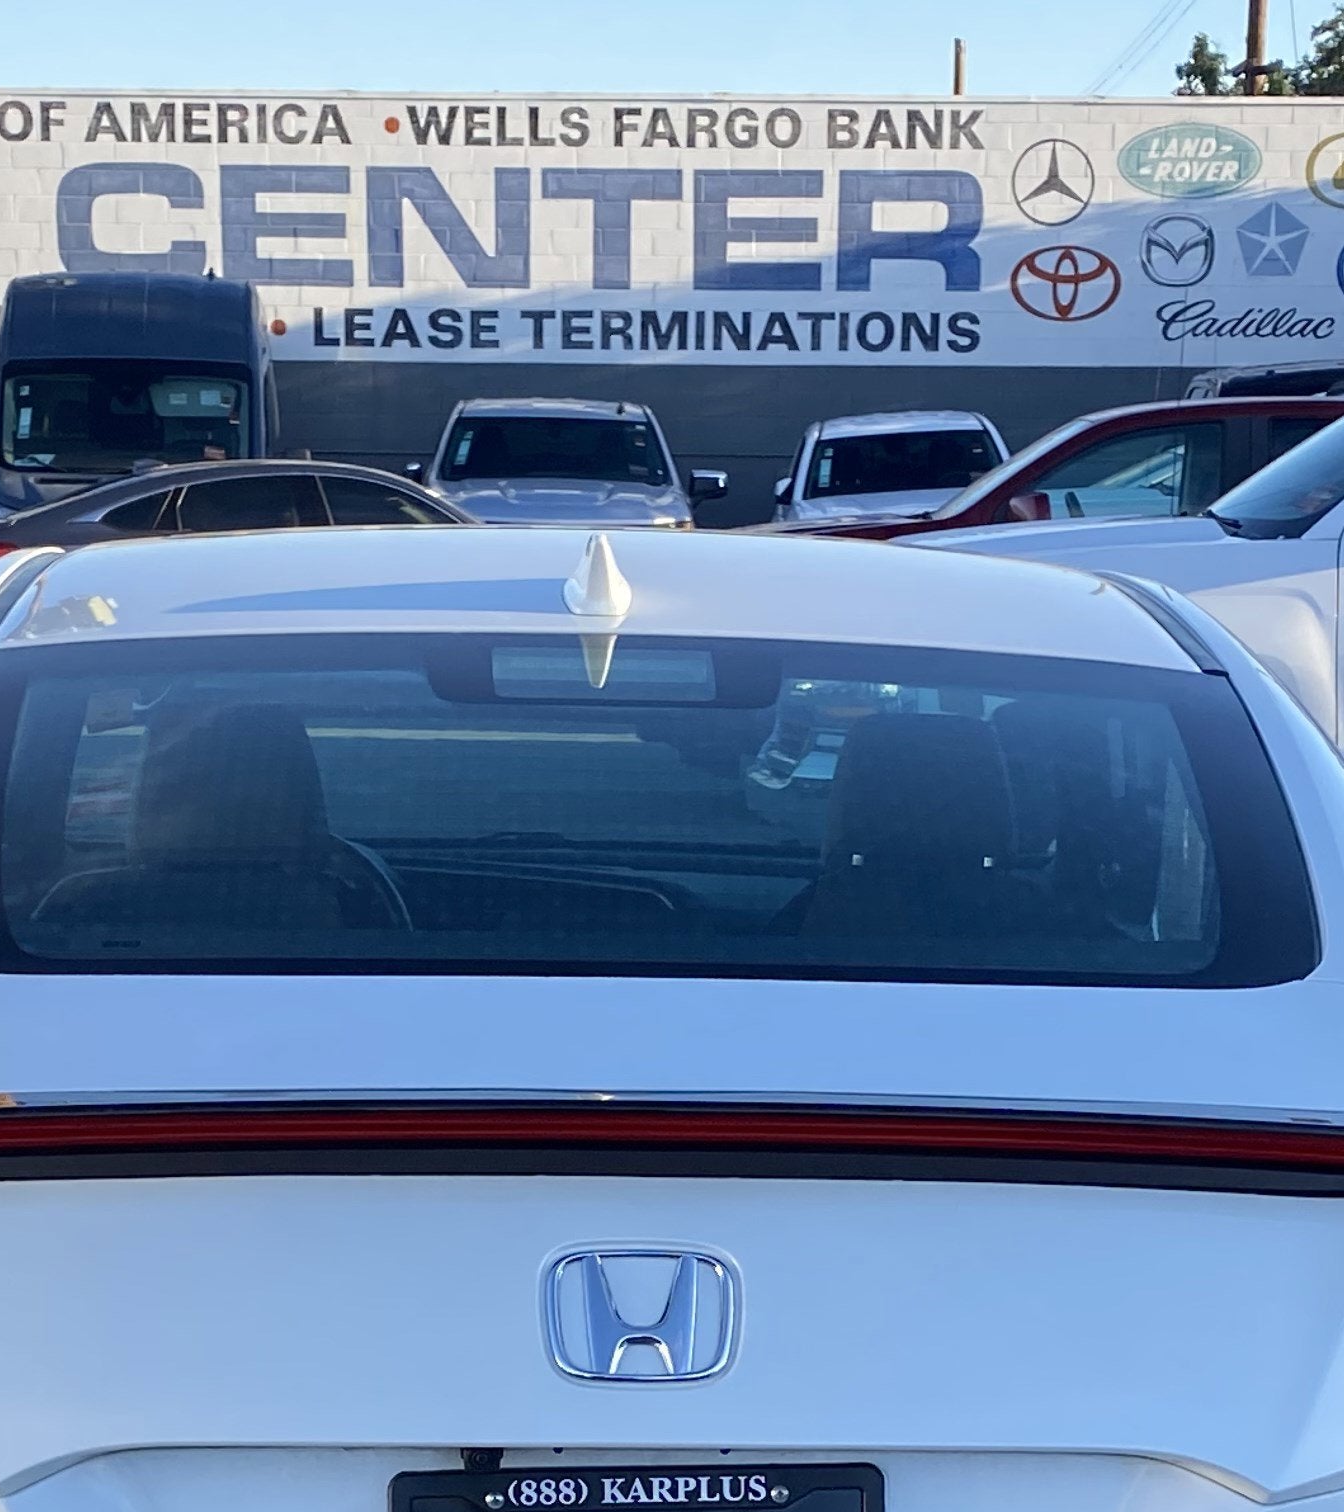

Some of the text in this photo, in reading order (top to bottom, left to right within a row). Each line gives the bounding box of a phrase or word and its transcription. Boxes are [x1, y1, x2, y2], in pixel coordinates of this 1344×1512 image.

[85, 101, 352, 145] AMERICA
[406, 105, 590, 147] WELLS
[613, 106, 802, 150] FARGO
[827, 108, 985, 150] BANK
[56, 161, 984, 292] CENTER
[313, 307, 500, 349] LEASE
[520, 309, 982, 353] TERMINATIONS
[1156, 299, 1336, 341] Cadillac
[507, 1474, 768, 1507] (888) KARPLUS
